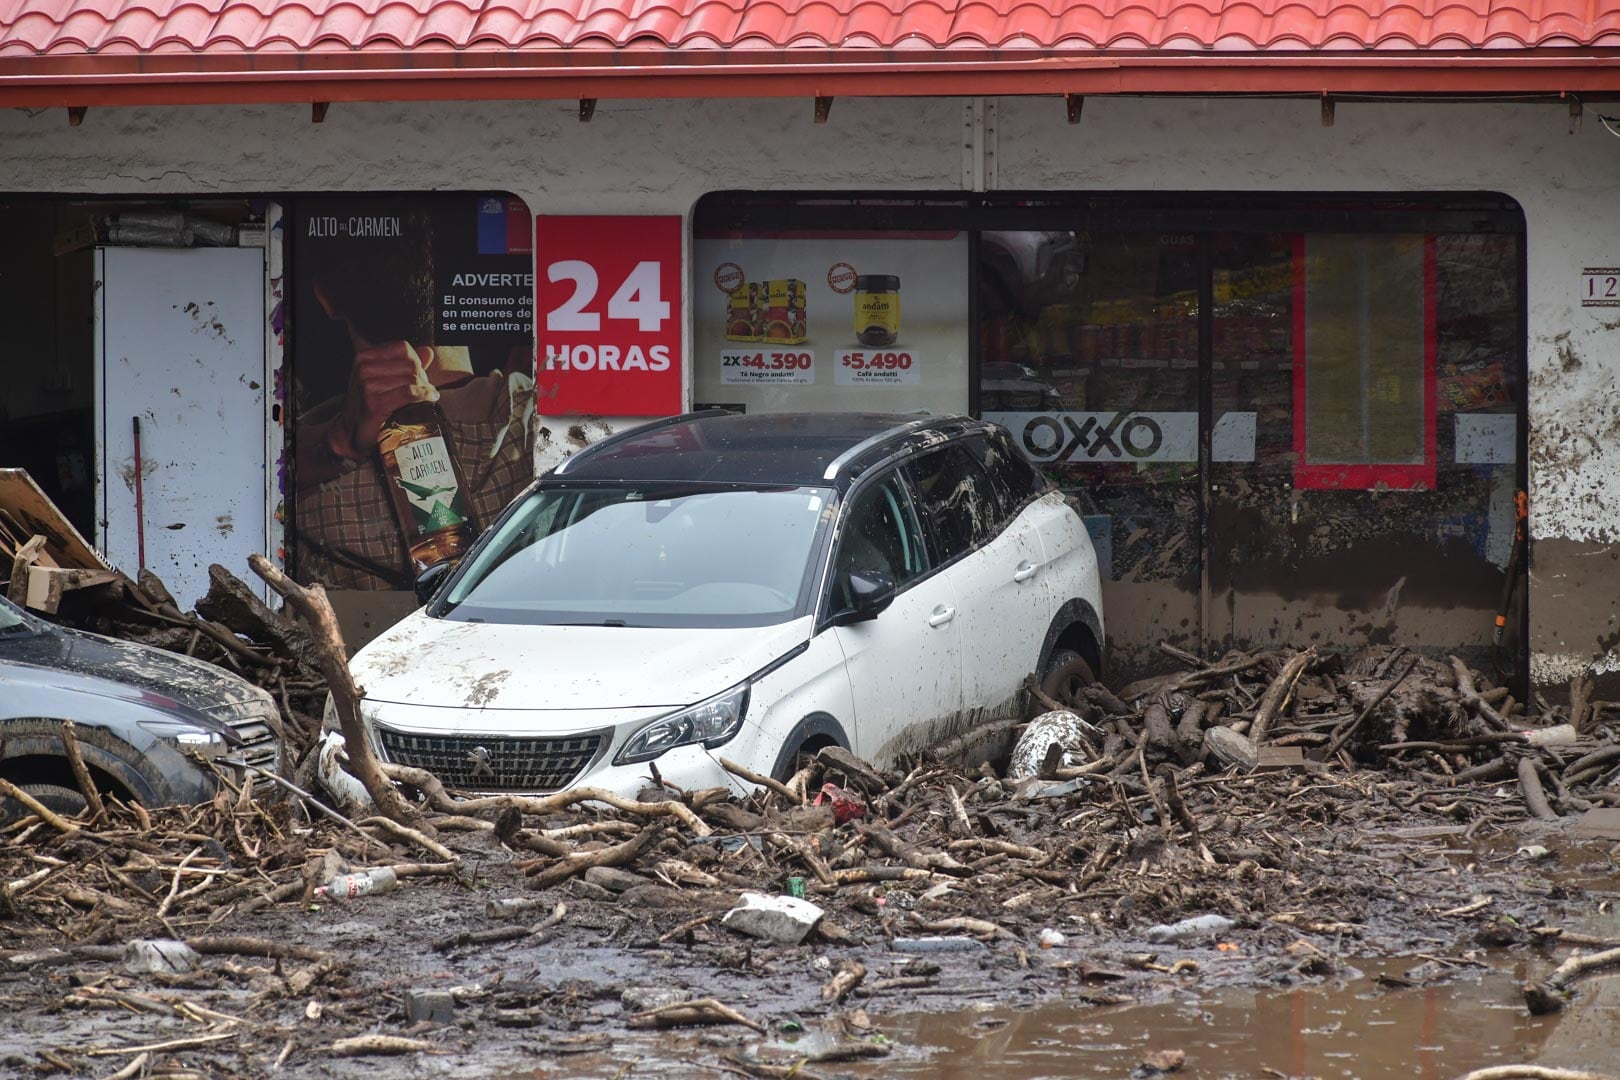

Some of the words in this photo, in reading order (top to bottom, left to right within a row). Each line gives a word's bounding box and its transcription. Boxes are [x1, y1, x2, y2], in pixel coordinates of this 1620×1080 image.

[308, 216, 338, 237] ALTO
[452, 273, 533, 287] ADVERTE
[1589, 276, 1617, 297] 12
[443, 295, 456, 305] El
[459, 297, 515, 305] consumo
[517, 295, 533, 305] de
[546, 259, 671, 332] 24
[442, 310, 457, 318] en
[460, 310, 513, 318] menores
[516, 308, 531, 318] de
[442, 322, 457, 331] se
[459, 321, 520, 331] encuentra
[546, 344, 670, 372] HORAS
[742, 353, 812, 370] $4.390
[842, 352, 912, 370] $5.490
[1022, 411, 1163, 462] OXXO
[412, 442, 432, 459] ALTO
